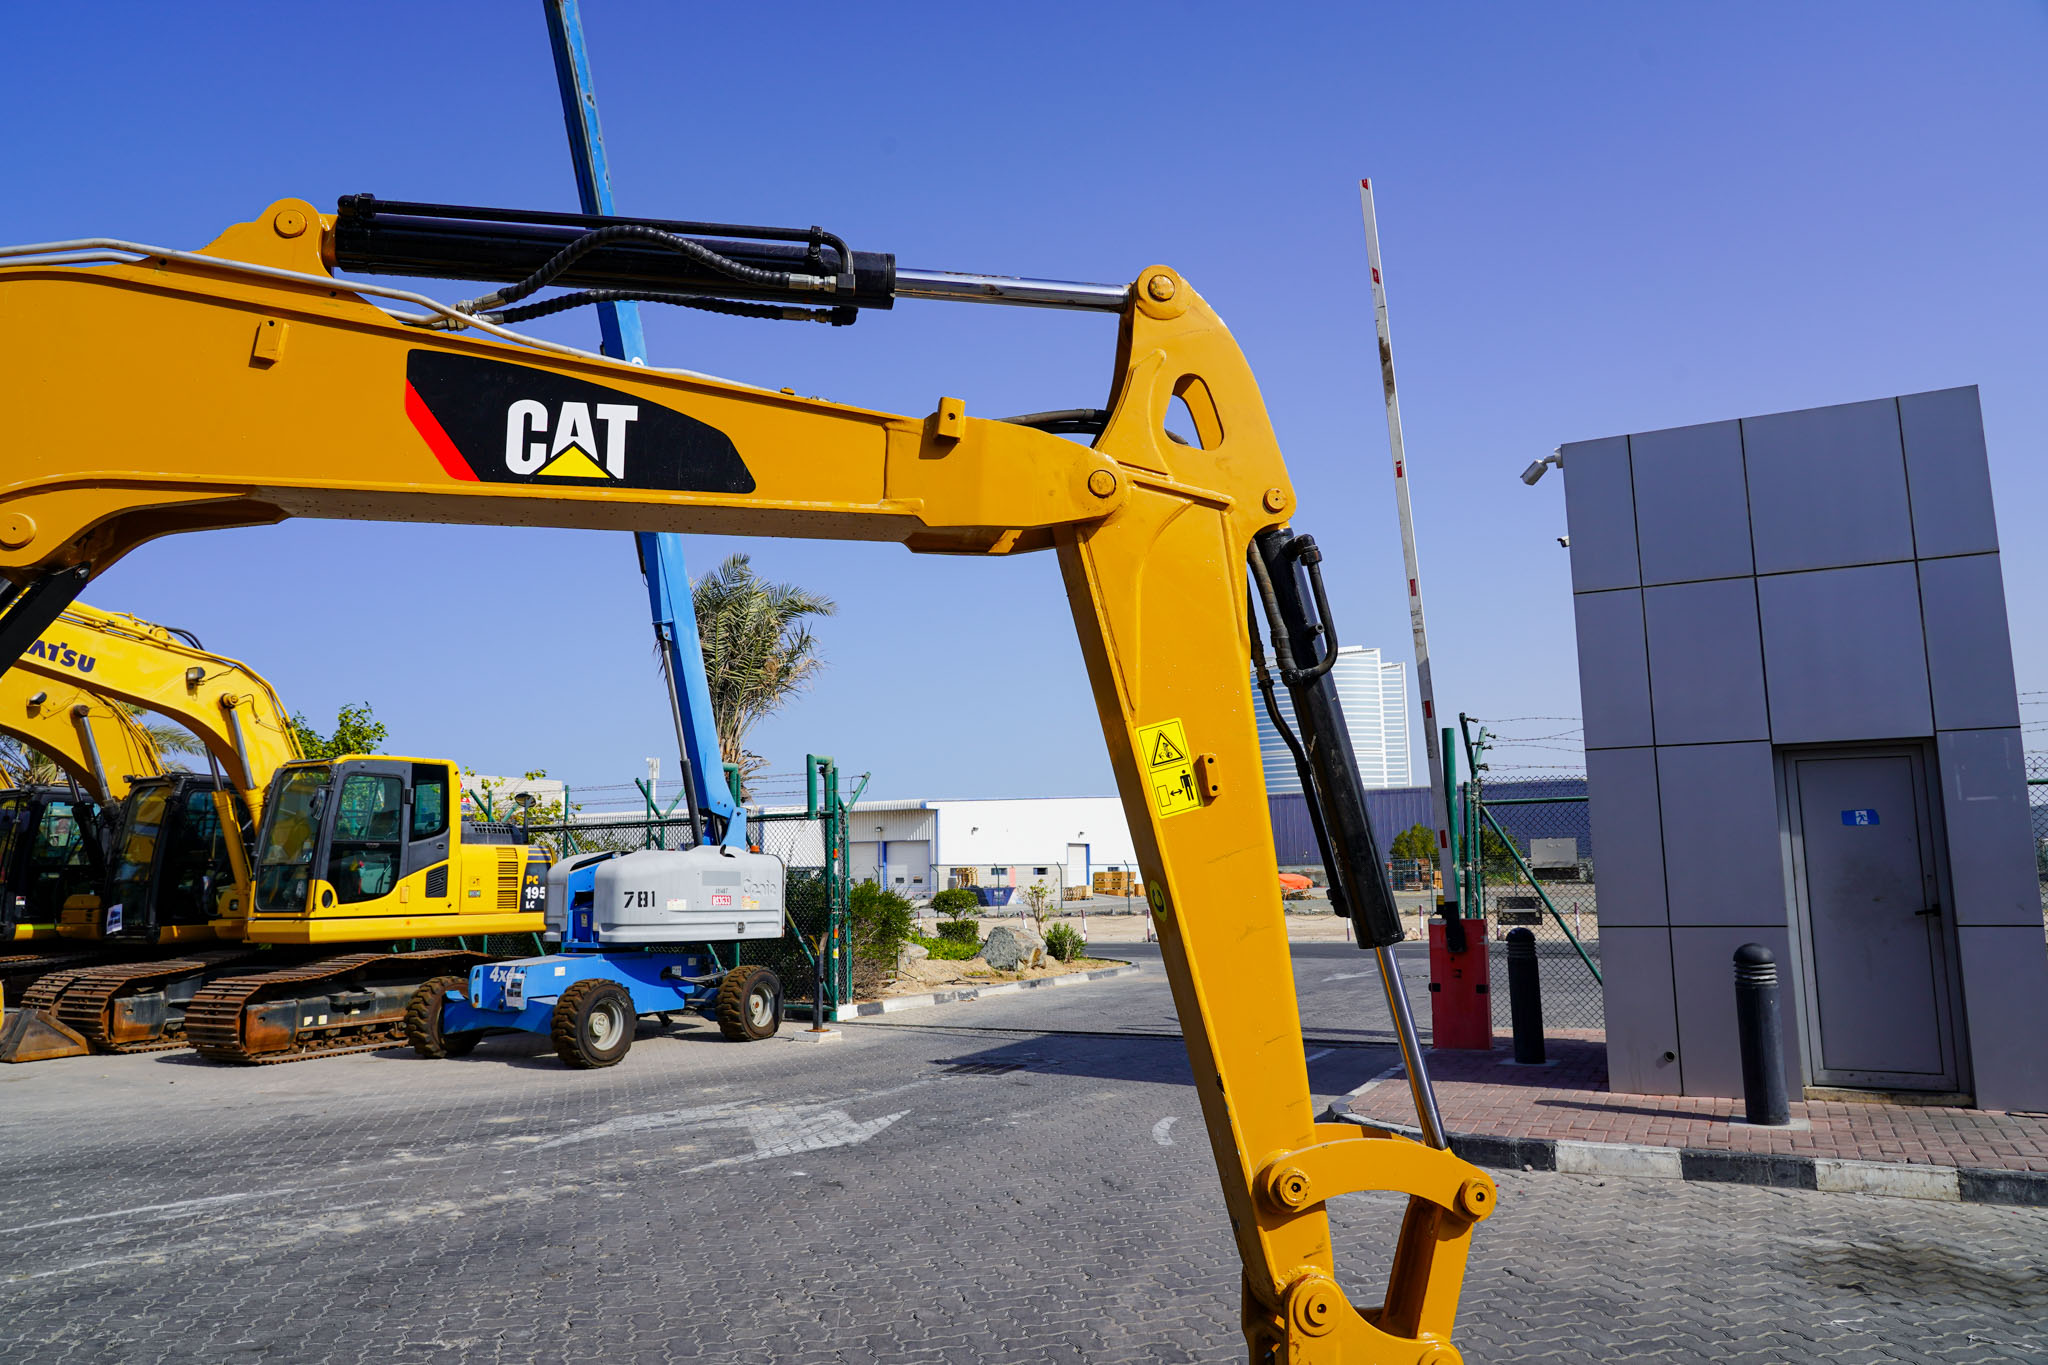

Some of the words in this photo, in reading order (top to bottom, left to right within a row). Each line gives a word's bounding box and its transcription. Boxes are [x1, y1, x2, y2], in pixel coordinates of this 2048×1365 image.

[505, 399, 638, 479] CAT
[27, 639, 96, 673] ATSU
[526, 875, 539, 885] PC
[525, 886, 546, 899] 195
[624, 890, 655, 908] 781
[525, 900, 535, 909] LC
